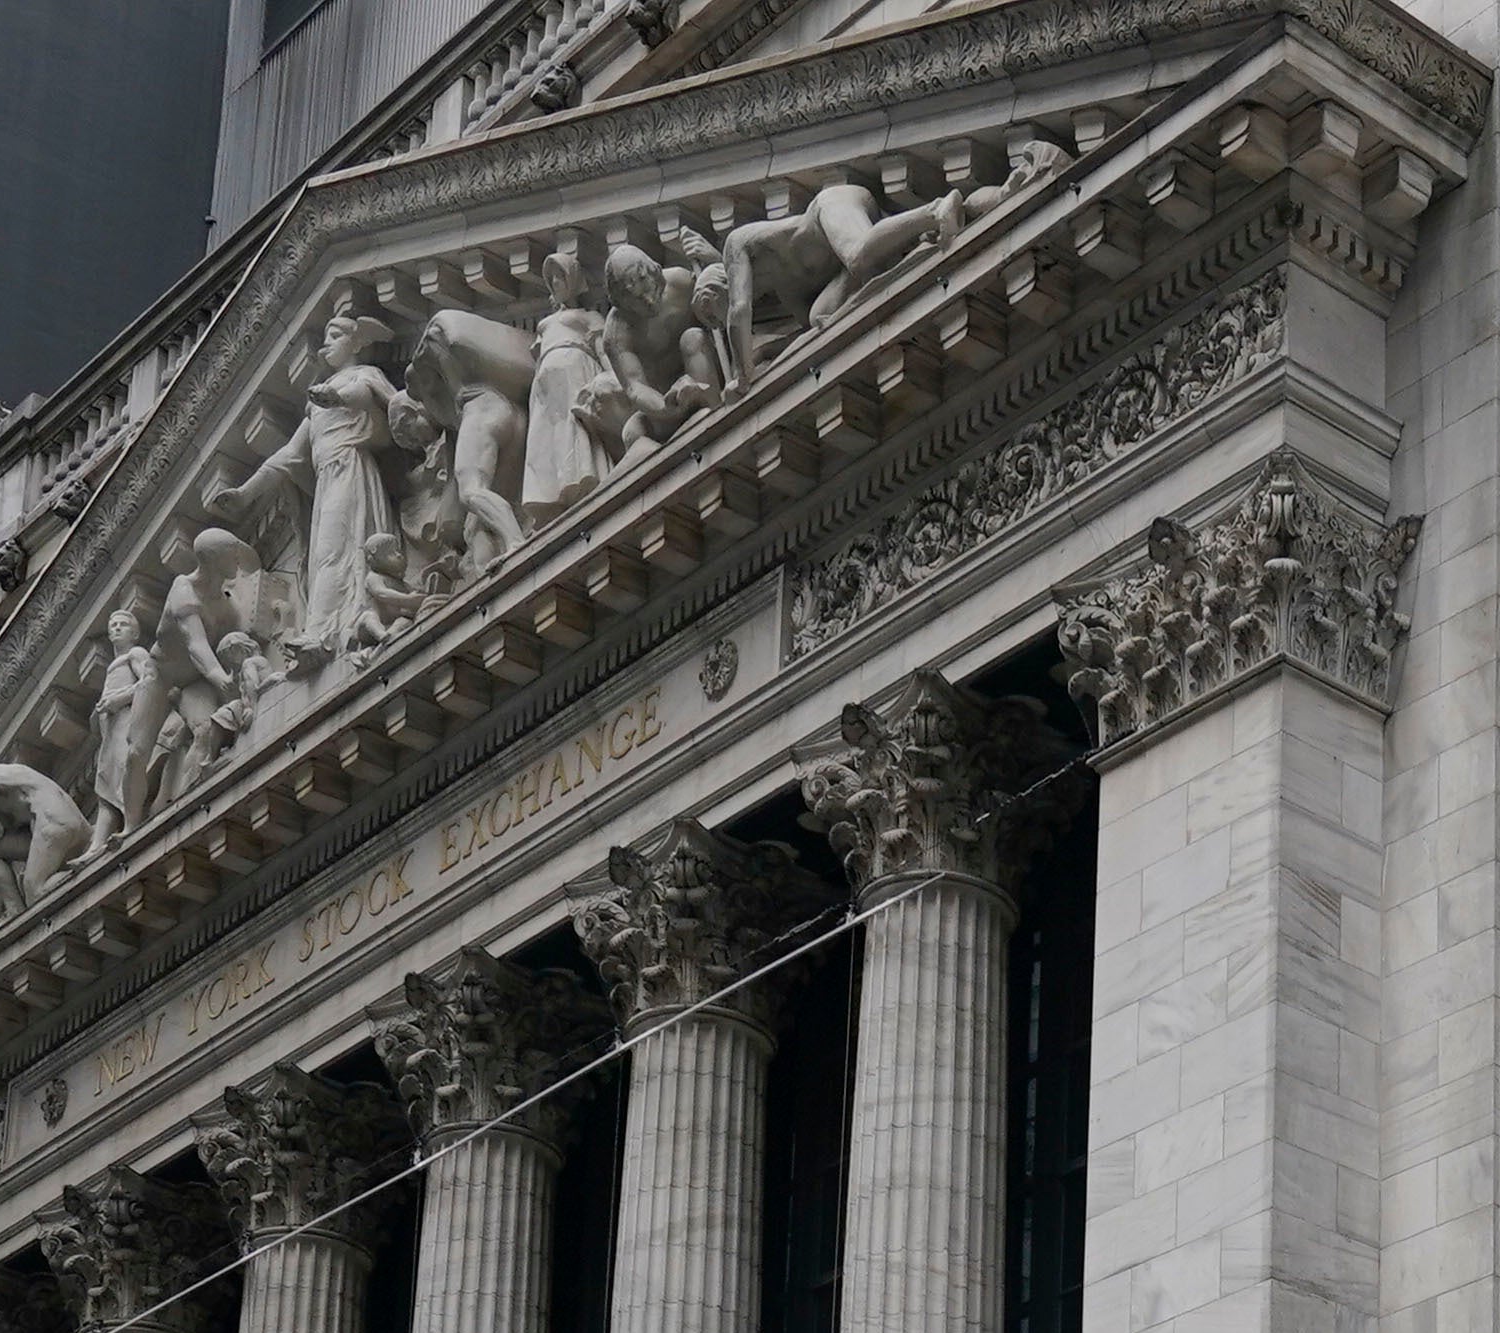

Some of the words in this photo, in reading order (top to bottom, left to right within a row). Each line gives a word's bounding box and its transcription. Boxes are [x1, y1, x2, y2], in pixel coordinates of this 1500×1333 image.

[94, 1012, 165, 1097] NEW
[184, 939, 276, 1037] YORK
[299, 849, 414, 962] STOCK
[439, 686, 662, 876] EXCHANGE
